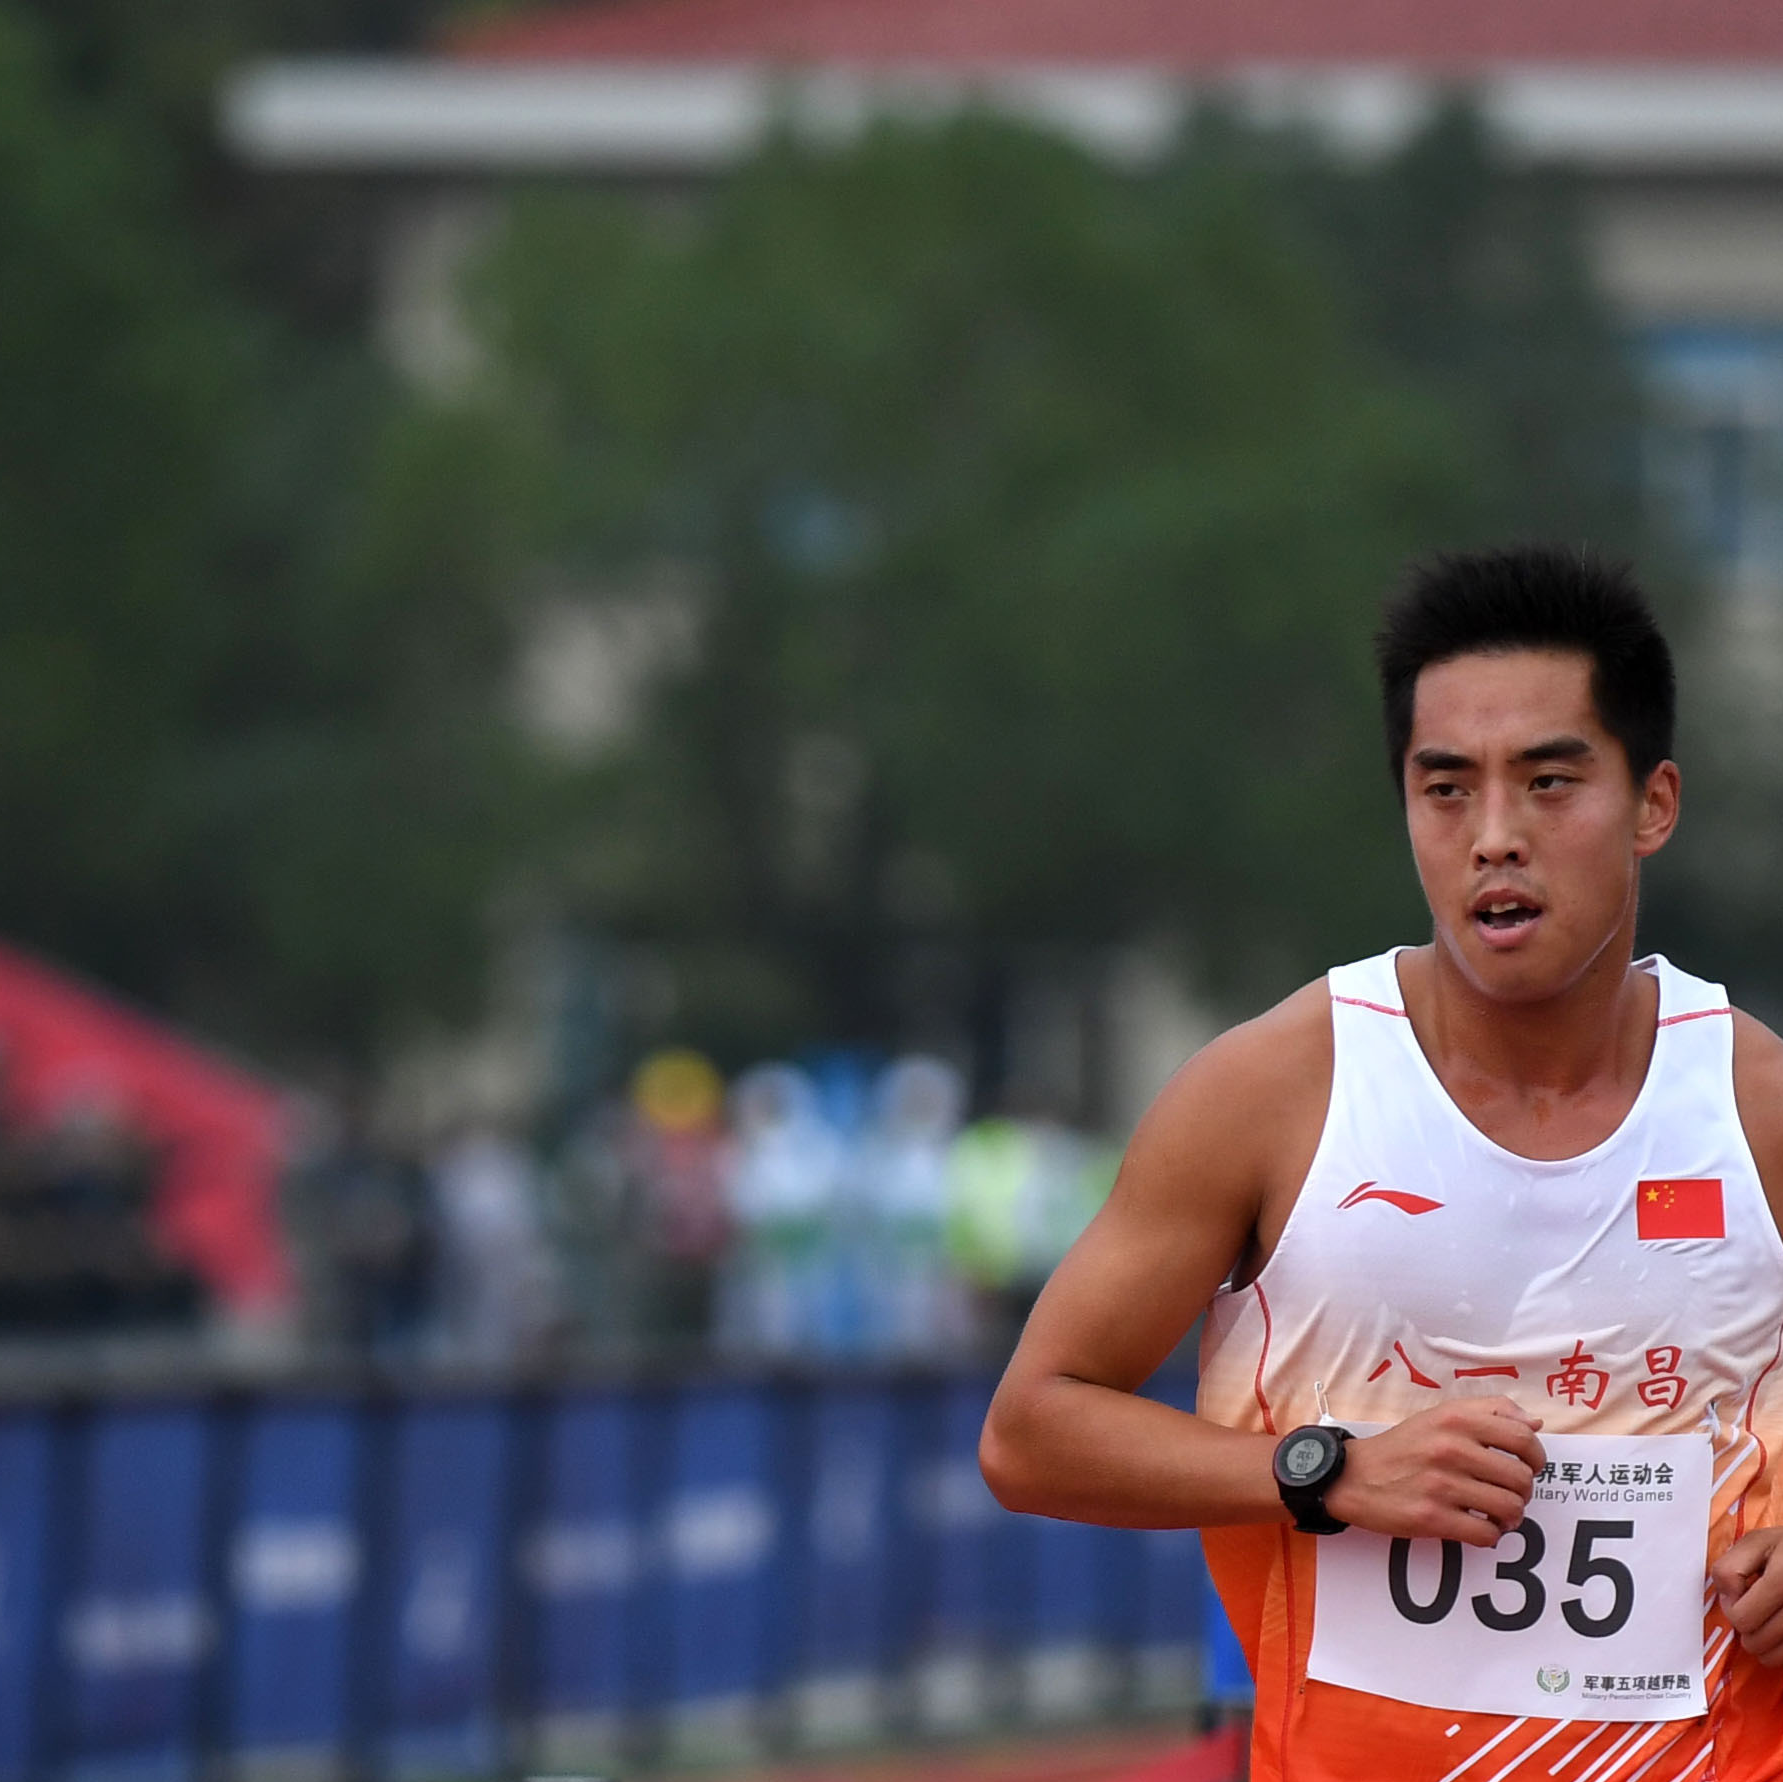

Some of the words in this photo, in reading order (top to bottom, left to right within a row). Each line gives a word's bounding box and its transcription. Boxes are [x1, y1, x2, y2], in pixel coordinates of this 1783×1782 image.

[1367, 1339, 1688, 1411] 八一南昌
[1534, 1462, 1674, 1485] 界军人运动会
[1534, 1486, 1570, 1504] itary
[1574, 1487, 1619, 1502] World
[1623, 1488, 1674, 1502] Games
[1388, 1516, 1635, 1638] 035
[1583, 1674, 1691, 1692] 军事五项越野跑
